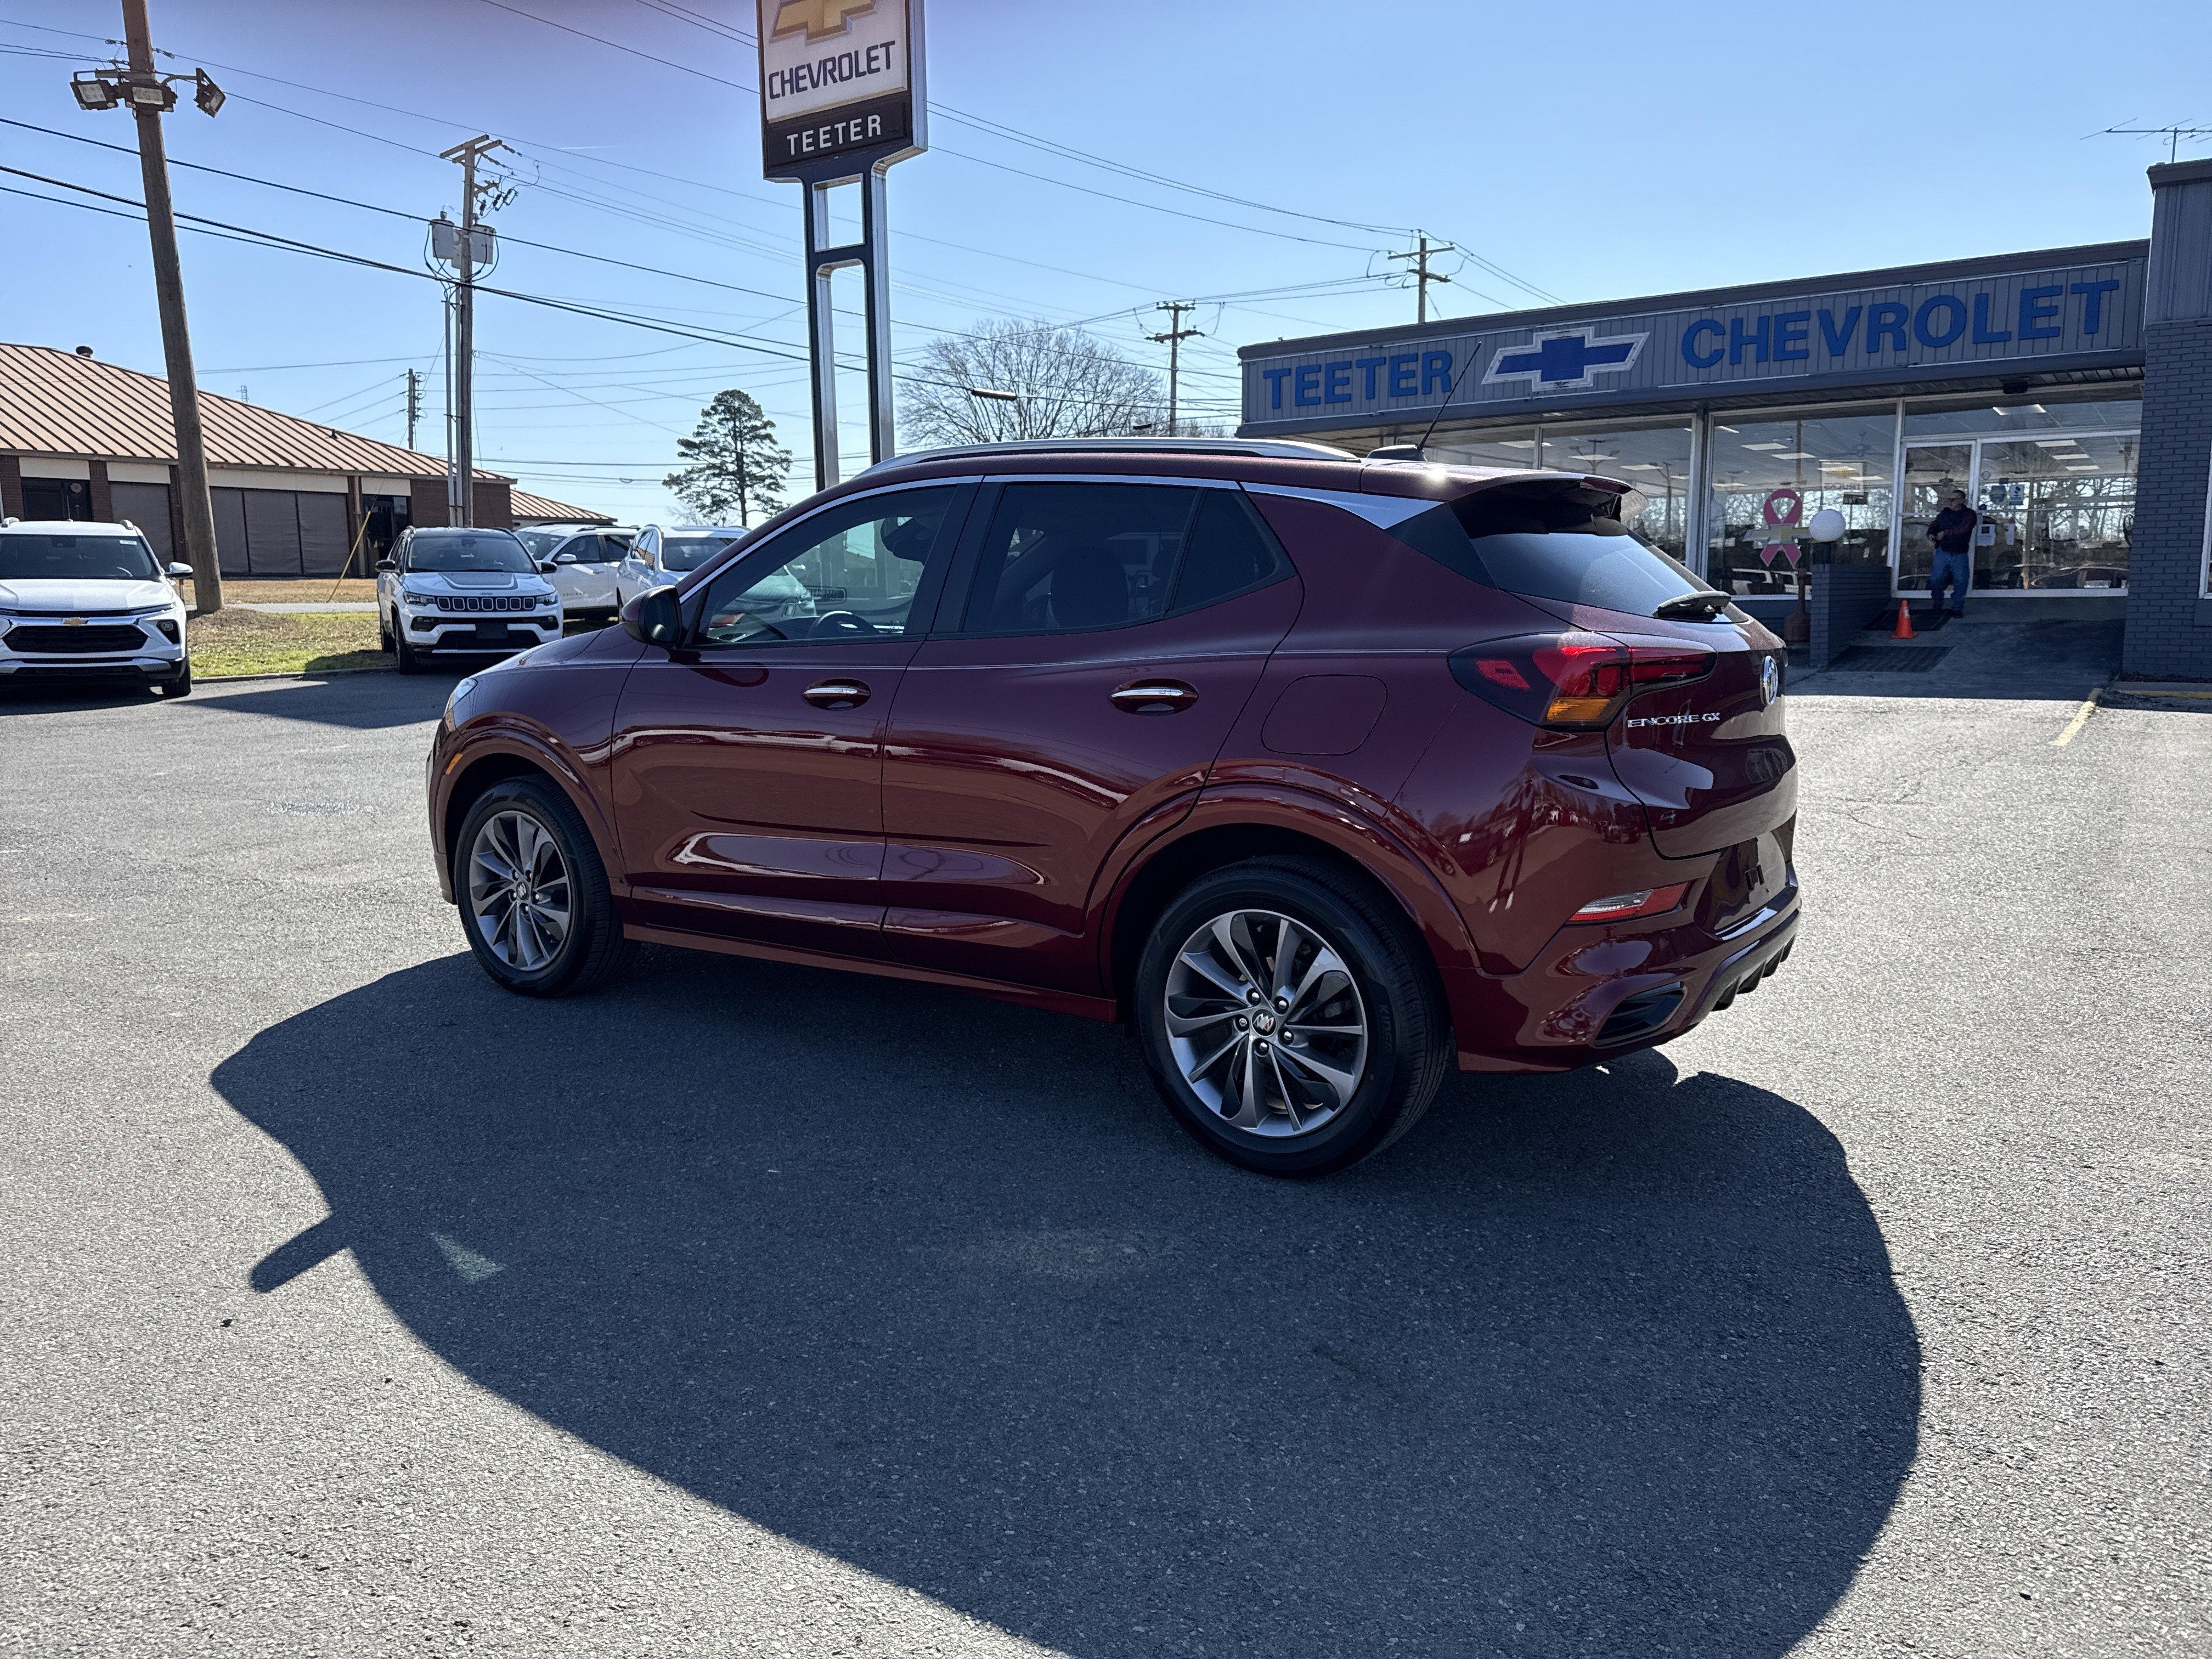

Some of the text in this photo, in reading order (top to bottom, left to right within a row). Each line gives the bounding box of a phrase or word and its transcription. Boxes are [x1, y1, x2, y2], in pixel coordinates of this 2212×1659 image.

[769, 40, 895, 99] CHEVROLET
[786, 114, 882, 156] TEETER
[1262, 279, 2120, 409] TEETER CHEVROLET
[1627, 712, 1720, 727] ENCORE GX
